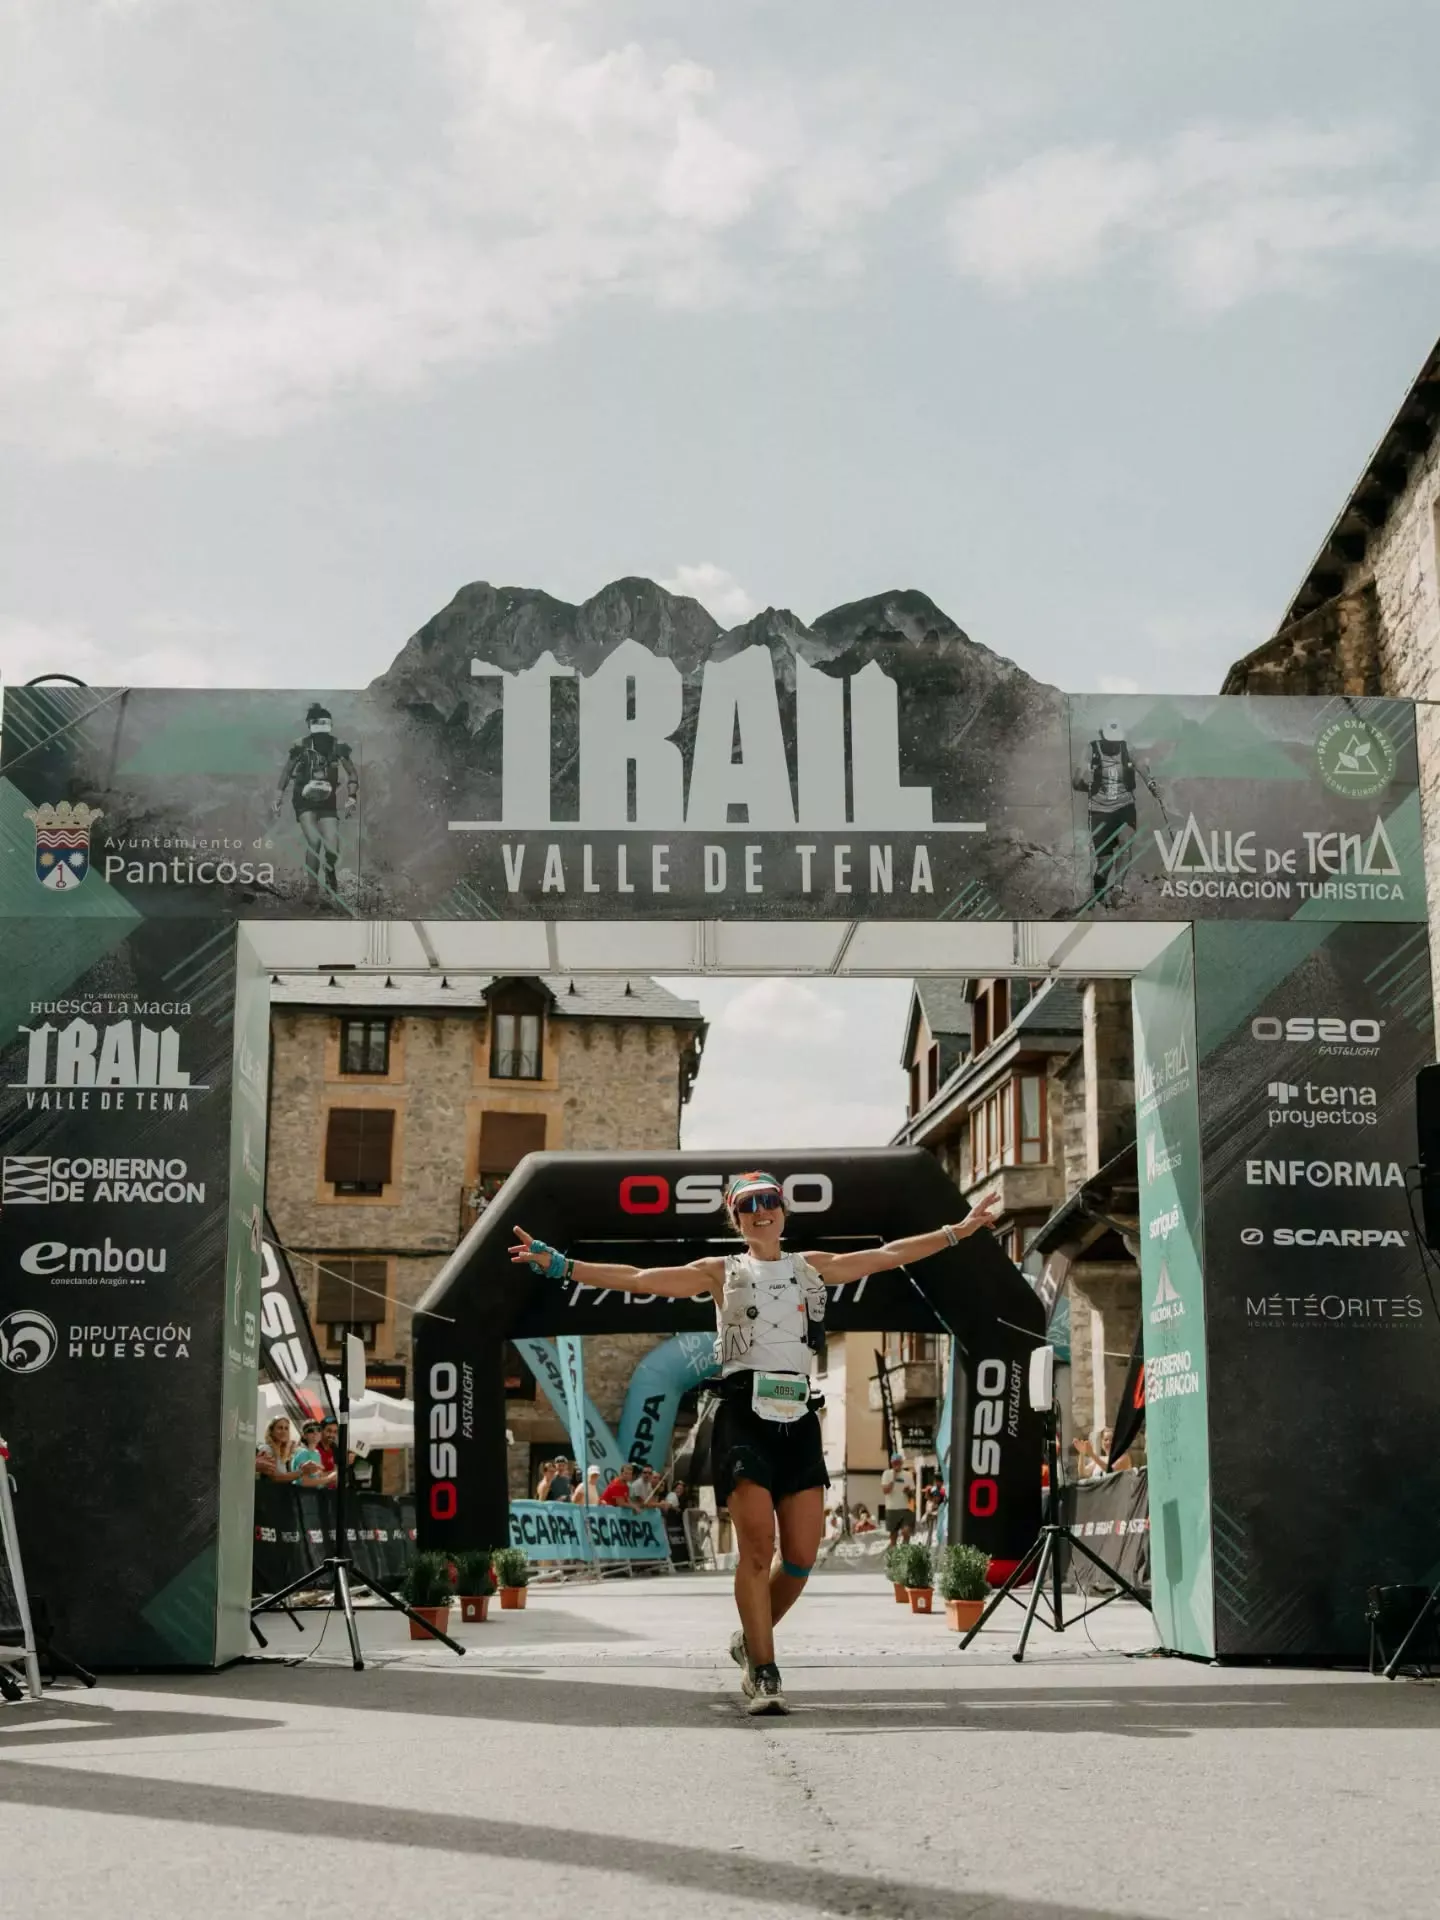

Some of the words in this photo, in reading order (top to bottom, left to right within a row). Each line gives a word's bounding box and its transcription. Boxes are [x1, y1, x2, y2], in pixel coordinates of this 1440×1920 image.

[471, 638, 933, 824] TRAIL
[104, 837, 243, 852] Ayuntamiento
[253, 837, 274, 849] de
[104, 854, 275, 885] Panticosa
[502, 844, 671, 893] VALLE
[705, 845, 762, 893] DE
[796, 845, 934, 893] TENA
[1161, 880, 1290, 900] ASOCIACION
[1297, 881, 1404, 901] TURISTICA
[18, 1017, 190, 1086] TRAIL
[1317, 1046, 1380, 1057] FAST&LIGHT
[26, 1092, 89, 1110] VALLE
[101, 1092, 124, 1110] DE
[137, 1092, 189, 1111] TENA
[1304, 1081, 1377, 1105] tena
[1268, 1109, 1377, 1127] proyectos
[52, 1158, 187, 1180] GOBIERNO
[1246, 1160, 1405, 1187] ENFORMA
[51, 1181, 84, 1202] DE
[93, 1182, 205, 1203] ARAGON
[1273, 1228, 1407, 1247] SCARPA
[20, 1237, 167, 1275] embou
[51, 1276, 98, 1285] conectando
[100, 1276, 128, 1287] Aragón
[69, 1322, 191, 1341] DIPUTACIÓN
[69, 1344, 189, 1358] HUESCA
[462, 1361, 473, 1439] FAST&LIGHT
[586, 1516, 660, 1547] SCARPA
